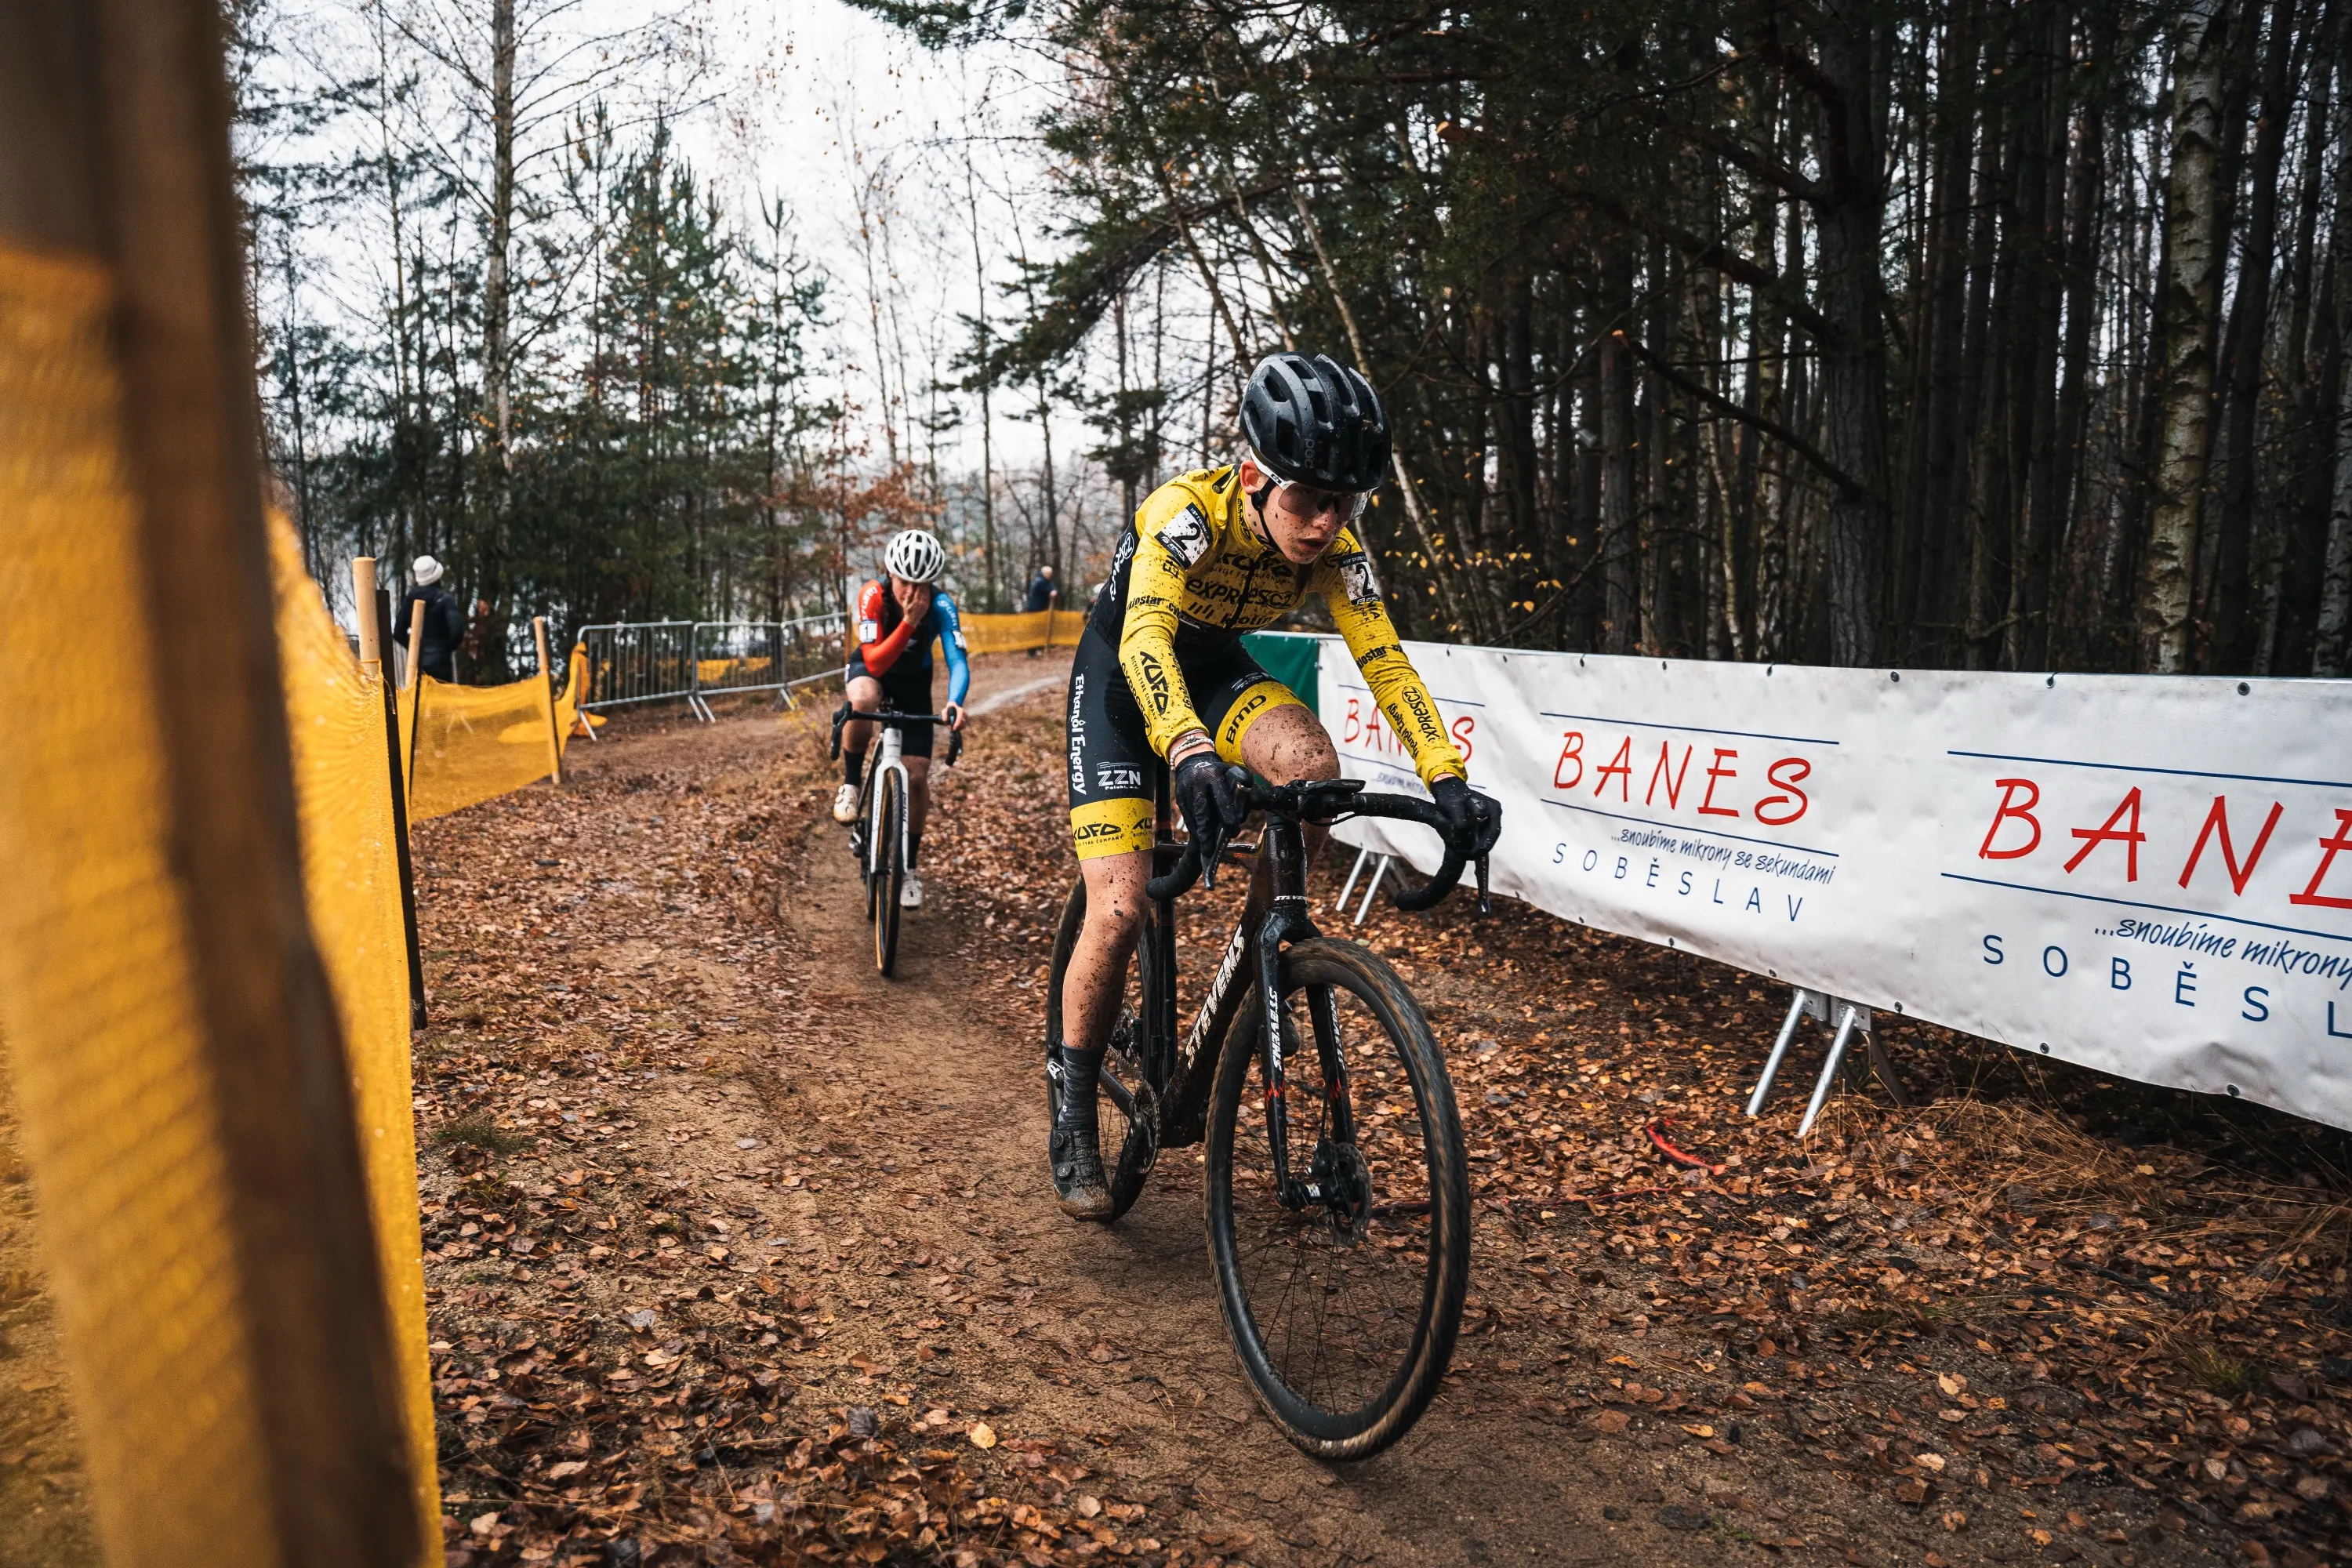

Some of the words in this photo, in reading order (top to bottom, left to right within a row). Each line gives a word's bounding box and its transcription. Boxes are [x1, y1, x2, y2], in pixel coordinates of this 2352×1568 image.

[1171, 522, 1201, 552] 2
[1356, 563, 1374, 597] 2
[1072, 673, 1087, 733] Ethanol
[1140, 652, 1168, 715] TUFO
[1069, 734, 1087, 796] Energy
[1097, 769, 1142, 787] ZZN
[1554, 731, 1812, 826] BANES
[1552, 842, 1803, 922] SOBĚSLAV
[1679, 838, 1733, 870] mikrony
[1734, 850, 1752, 868] se
[1755, 853, 1836, 884] sekundami
[1185, 924, 1245, 1070] STEVENS
[1269, 986, 1283, 1072] STEVENS
